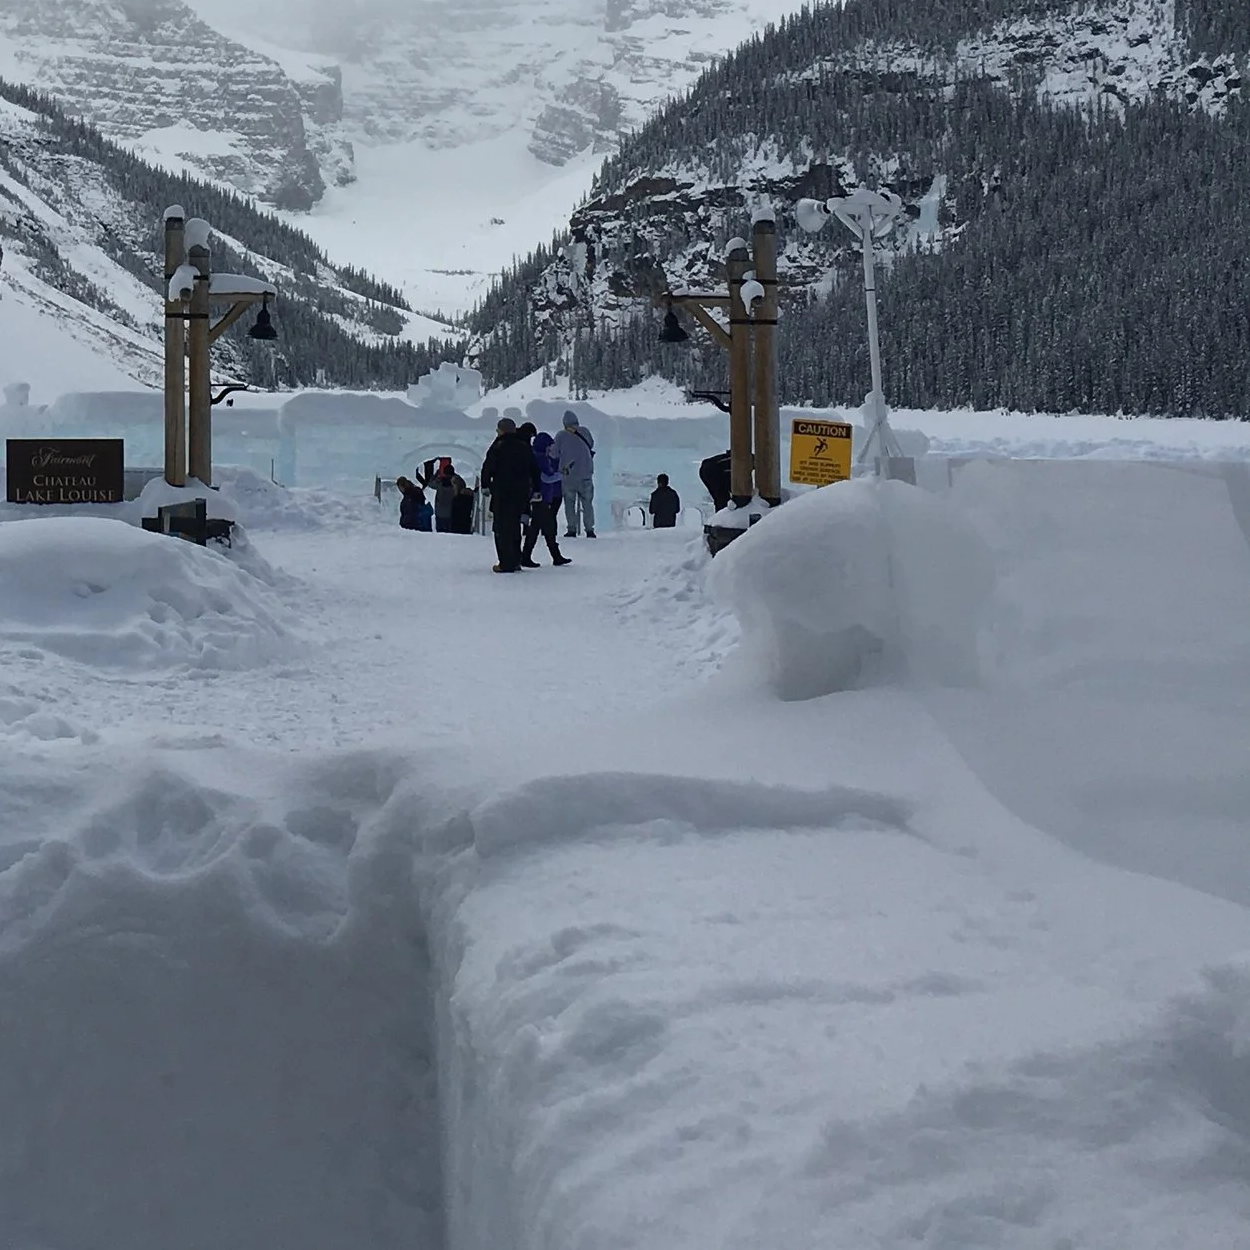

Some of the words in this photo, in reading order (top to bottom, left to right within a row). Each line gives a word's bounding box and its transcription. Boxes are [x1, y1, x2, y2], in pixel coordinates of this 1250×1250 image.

[798, 423, 847, 437] CAUTION
[31, 447, 97, 468] Fairmont
[33, 474, 96, 487] CHATEAU
[16, 488, 54, 502] LAKE
[59, 488, 115, 502] LOUISE
